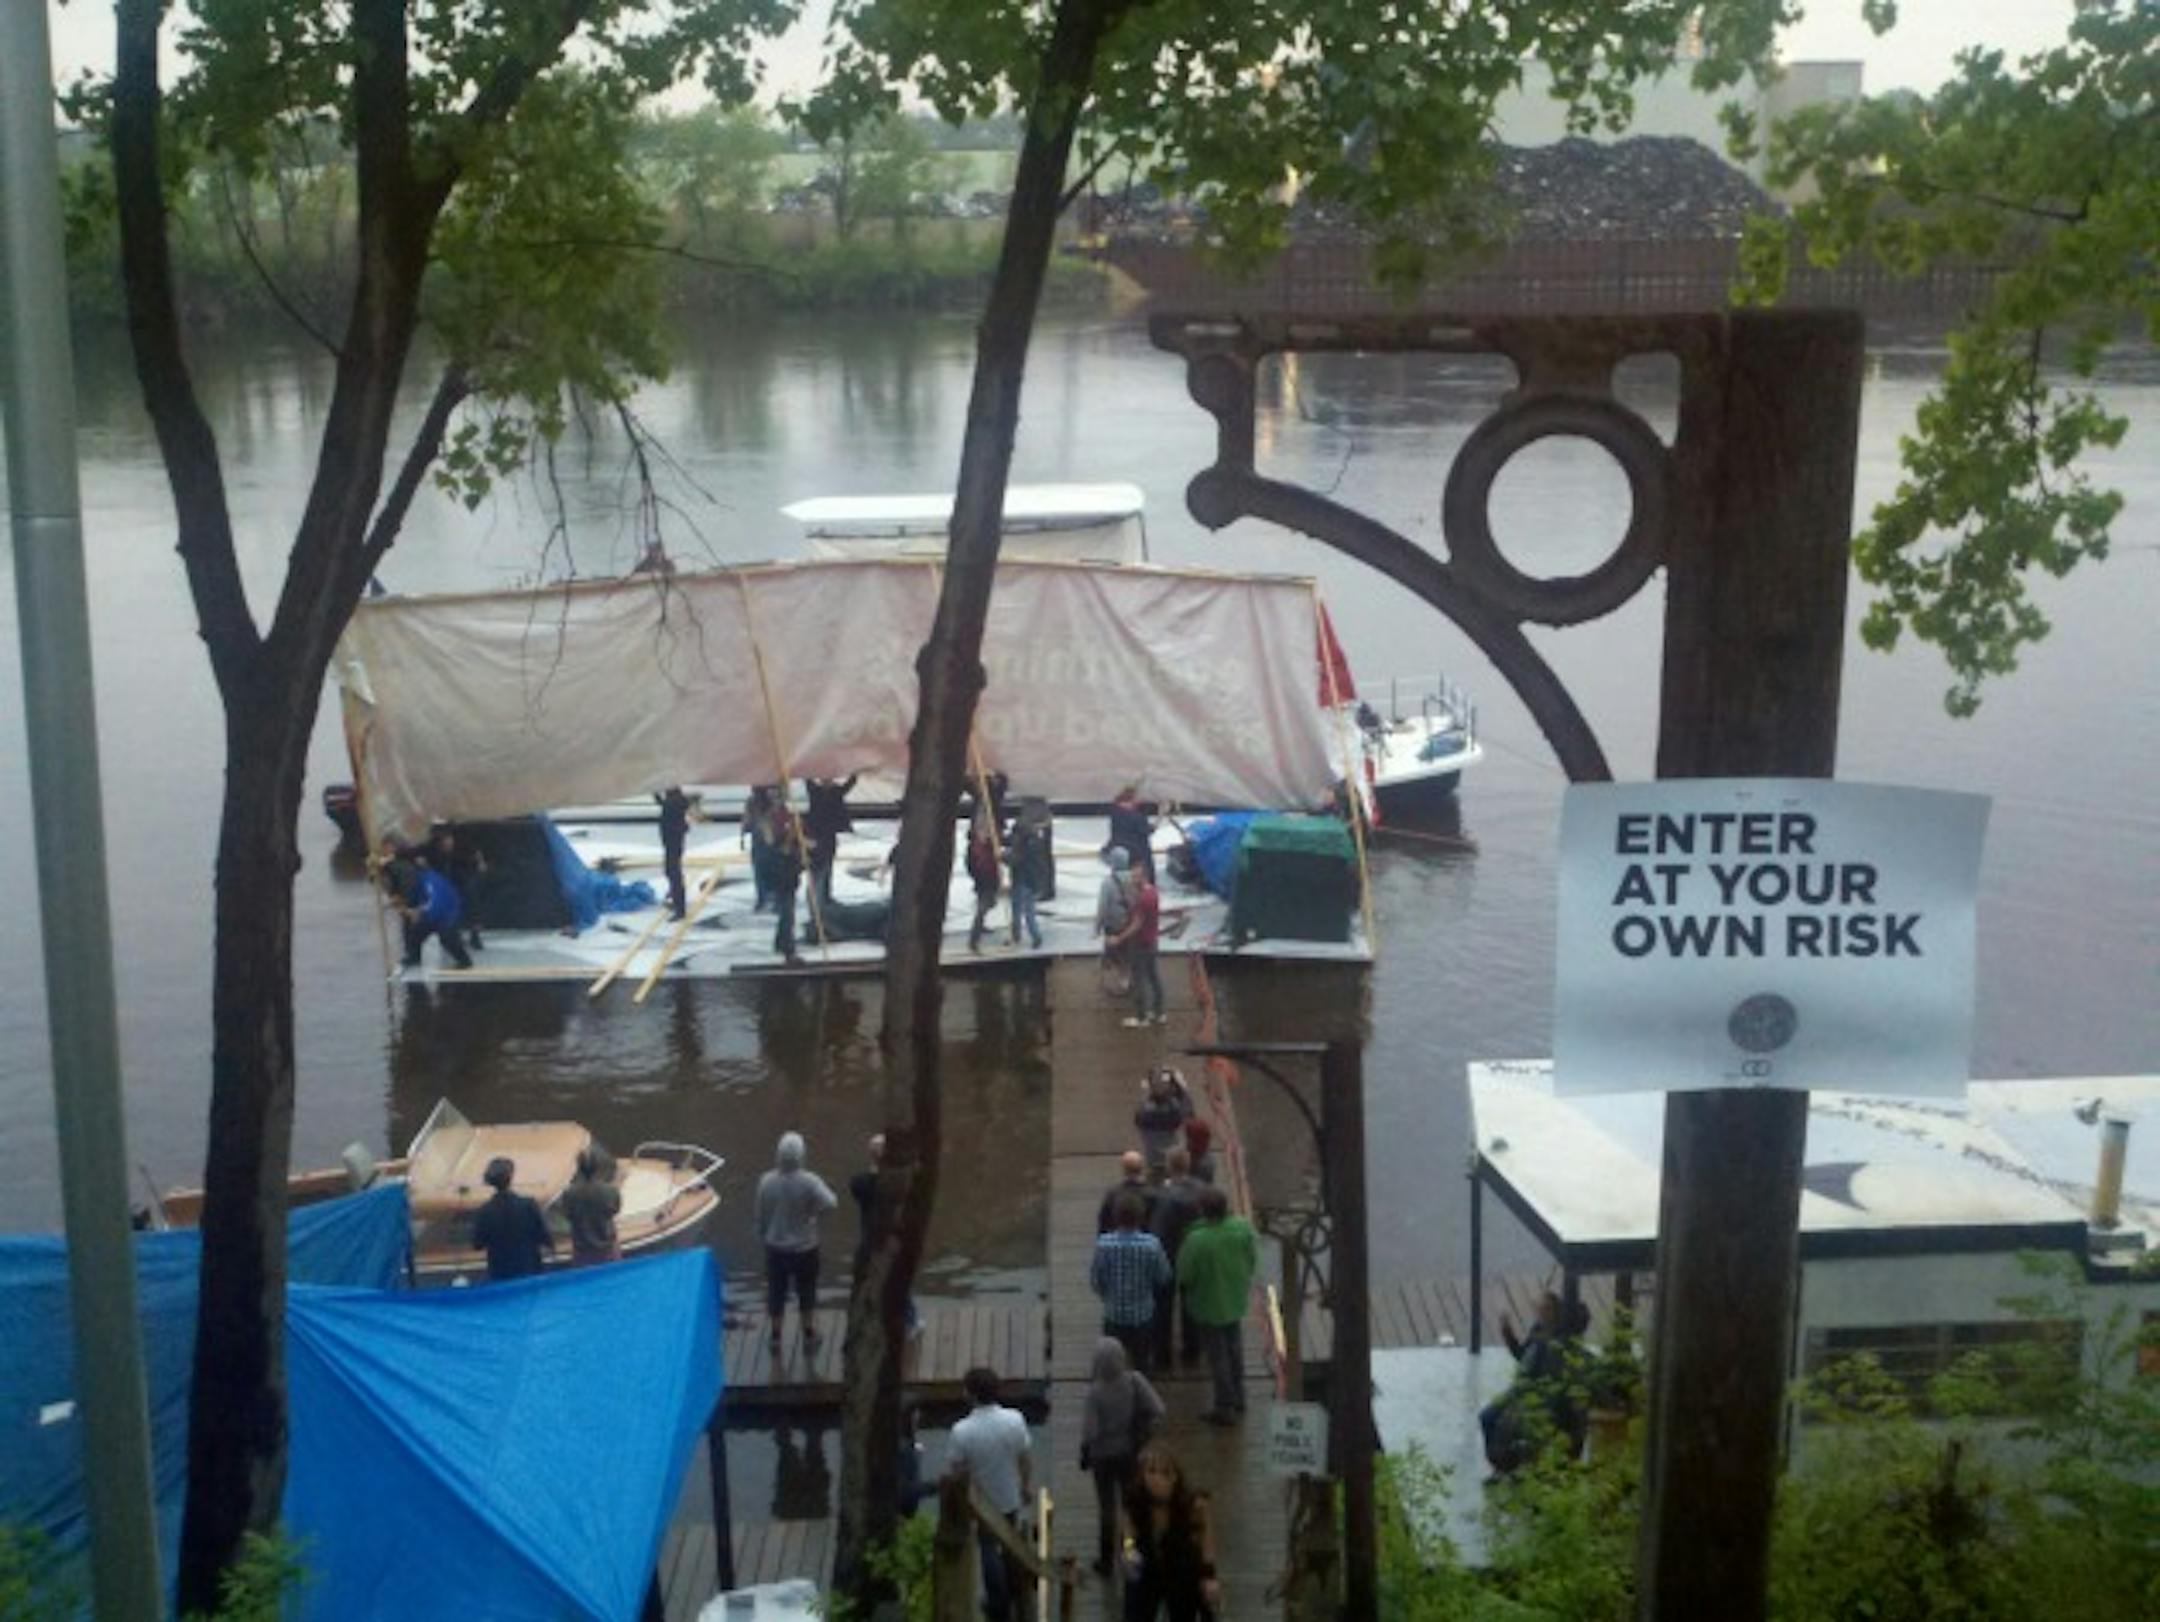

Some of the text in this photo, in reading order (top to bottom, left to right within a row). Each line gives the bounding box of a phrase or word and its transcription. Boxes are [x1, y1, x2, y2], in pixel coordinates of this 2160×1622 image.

[1616, 813, 1818, 854] ENTER
[1613, 864, 1878, 906] AT YOUR
[1612, 914, 1923, 958] OWN RISK
